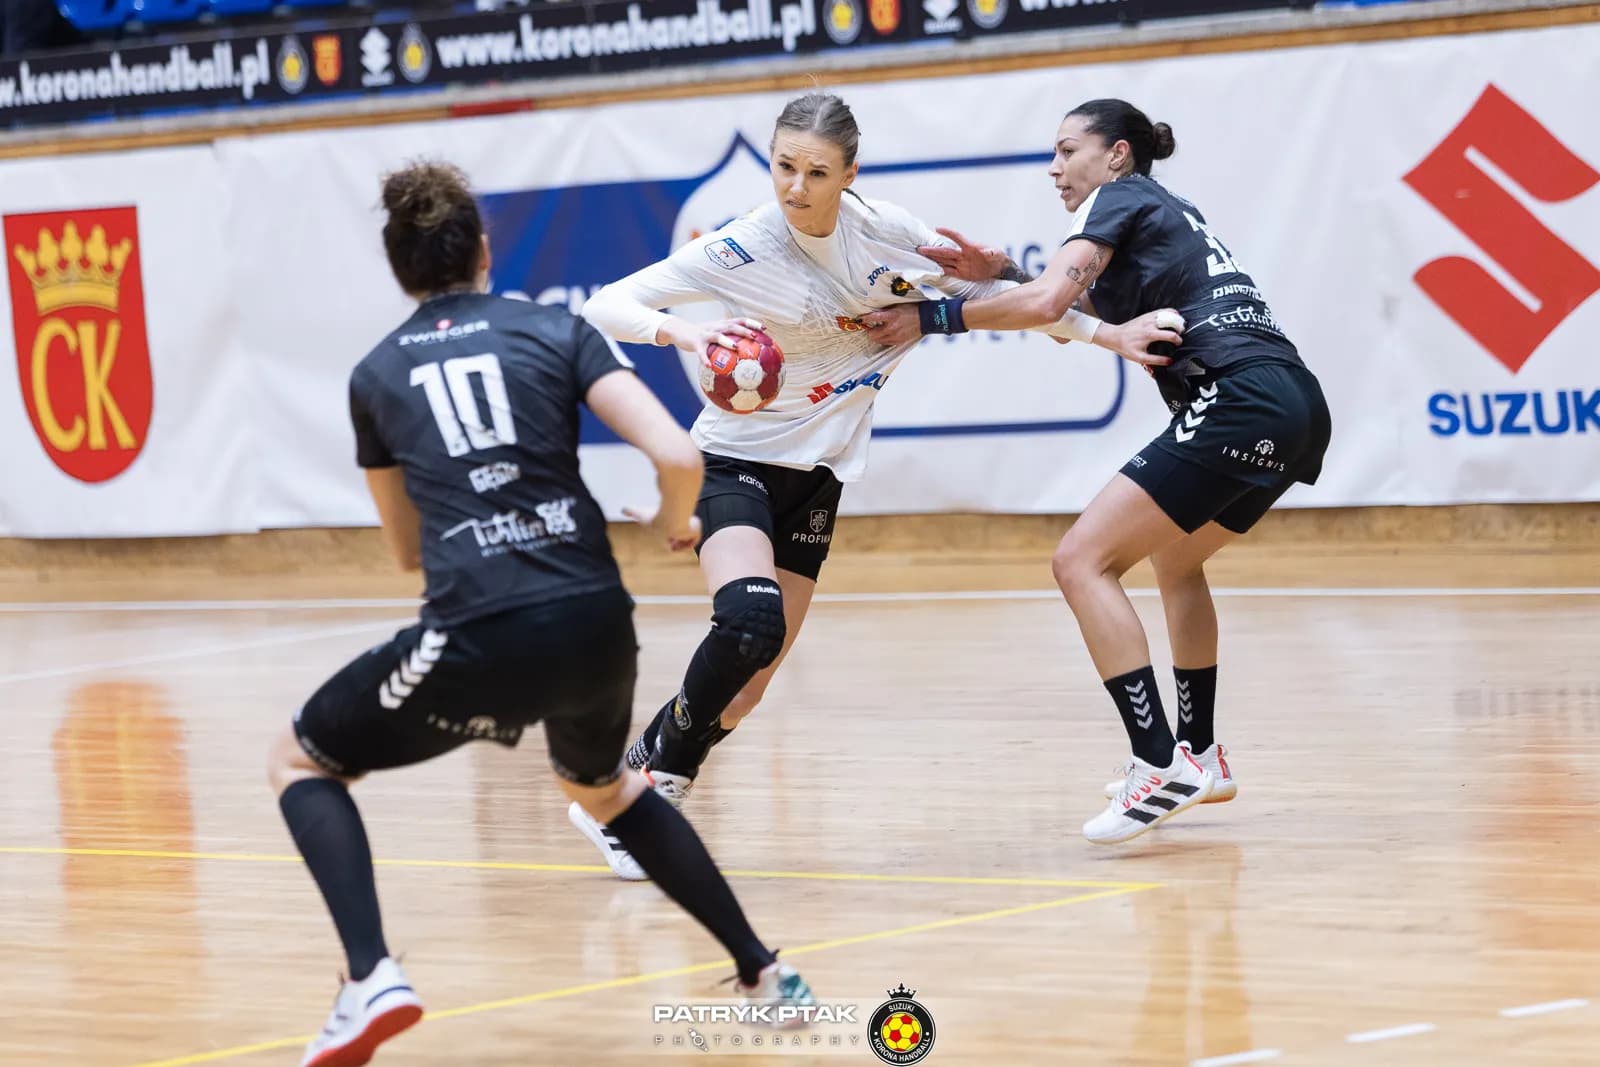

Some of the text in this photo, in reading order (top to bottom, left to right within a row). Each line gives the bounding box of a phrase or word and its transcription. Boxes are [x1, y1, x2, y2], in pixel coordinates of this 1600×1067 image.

[436, 0, 816, 68] www.koronahandball.pl
[31, 316, 137, 453] CK
[409, 352, 518, 458] 10
[1426, 390, 1600, 437] SUZUK
[1220, 445, 1286, 472] INSIGNIS
